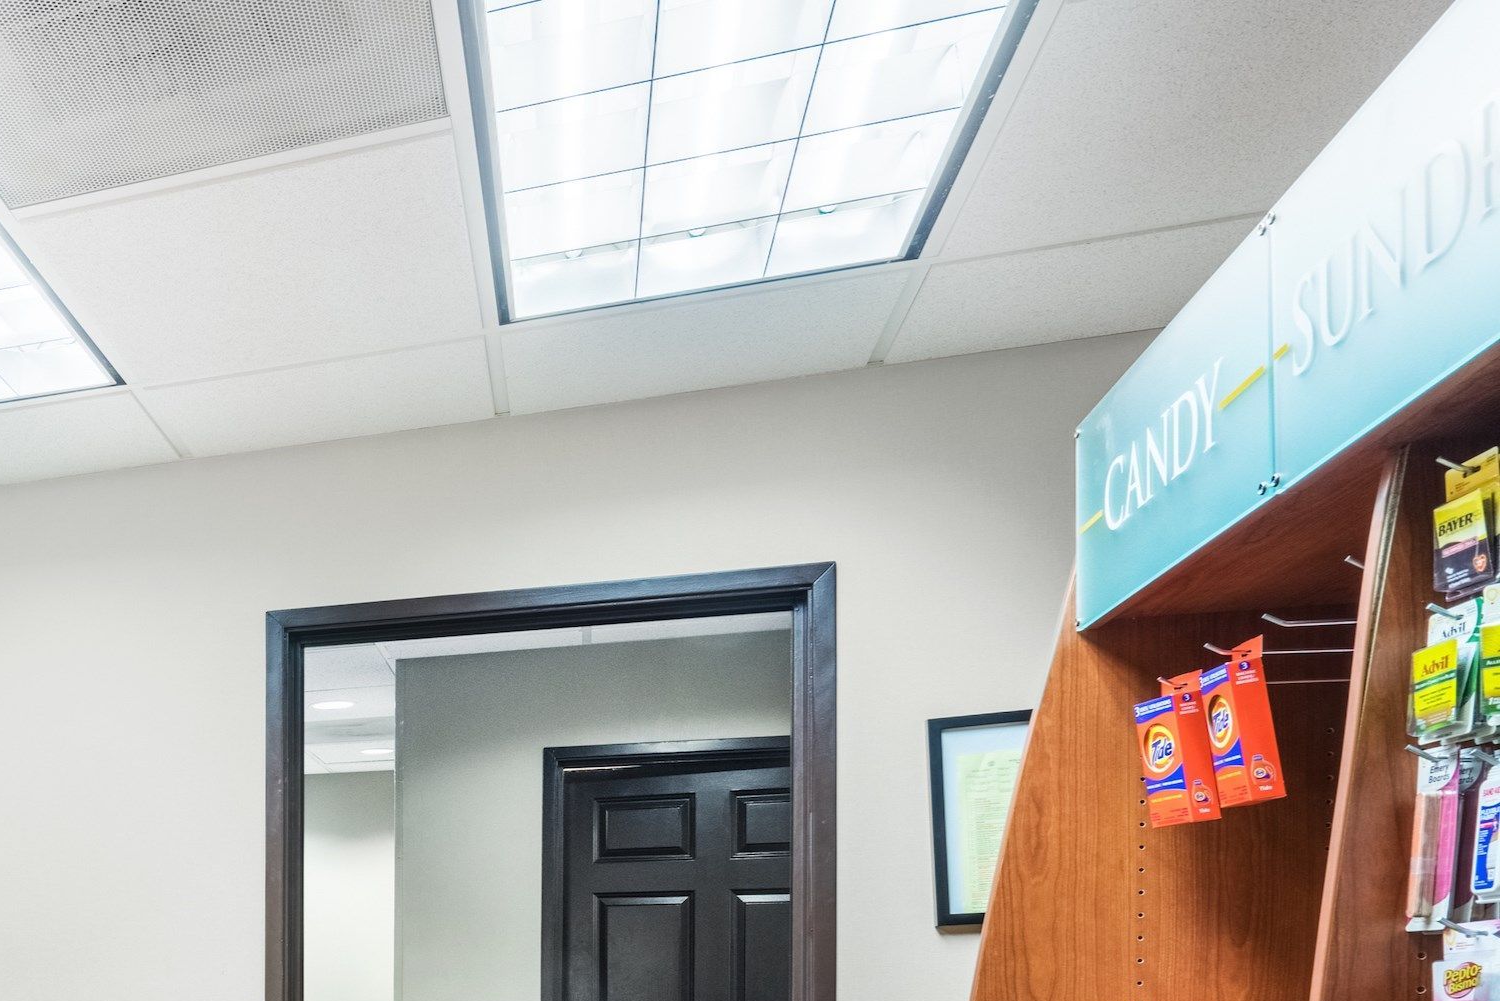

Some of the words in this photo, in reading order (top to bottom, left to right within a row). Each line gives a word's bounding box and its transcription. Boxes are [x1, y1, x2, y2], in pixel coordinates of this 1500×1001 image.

[1102, 356, 1227, 532] CANDY
[1291, 95, 1500, 377] SUND
[1438, 512, 1474, 537] BAYER
[1421, 655, 1449, 678] Advil
[1213, 710, 1230, 735] Tide
[1151, 738, 1173, 762] Tide
[1428, 773, 1450, 785] Boards
[1430, 764, 1449, 775] Emery
[1443, 964, 1482, 981] Pepto-
